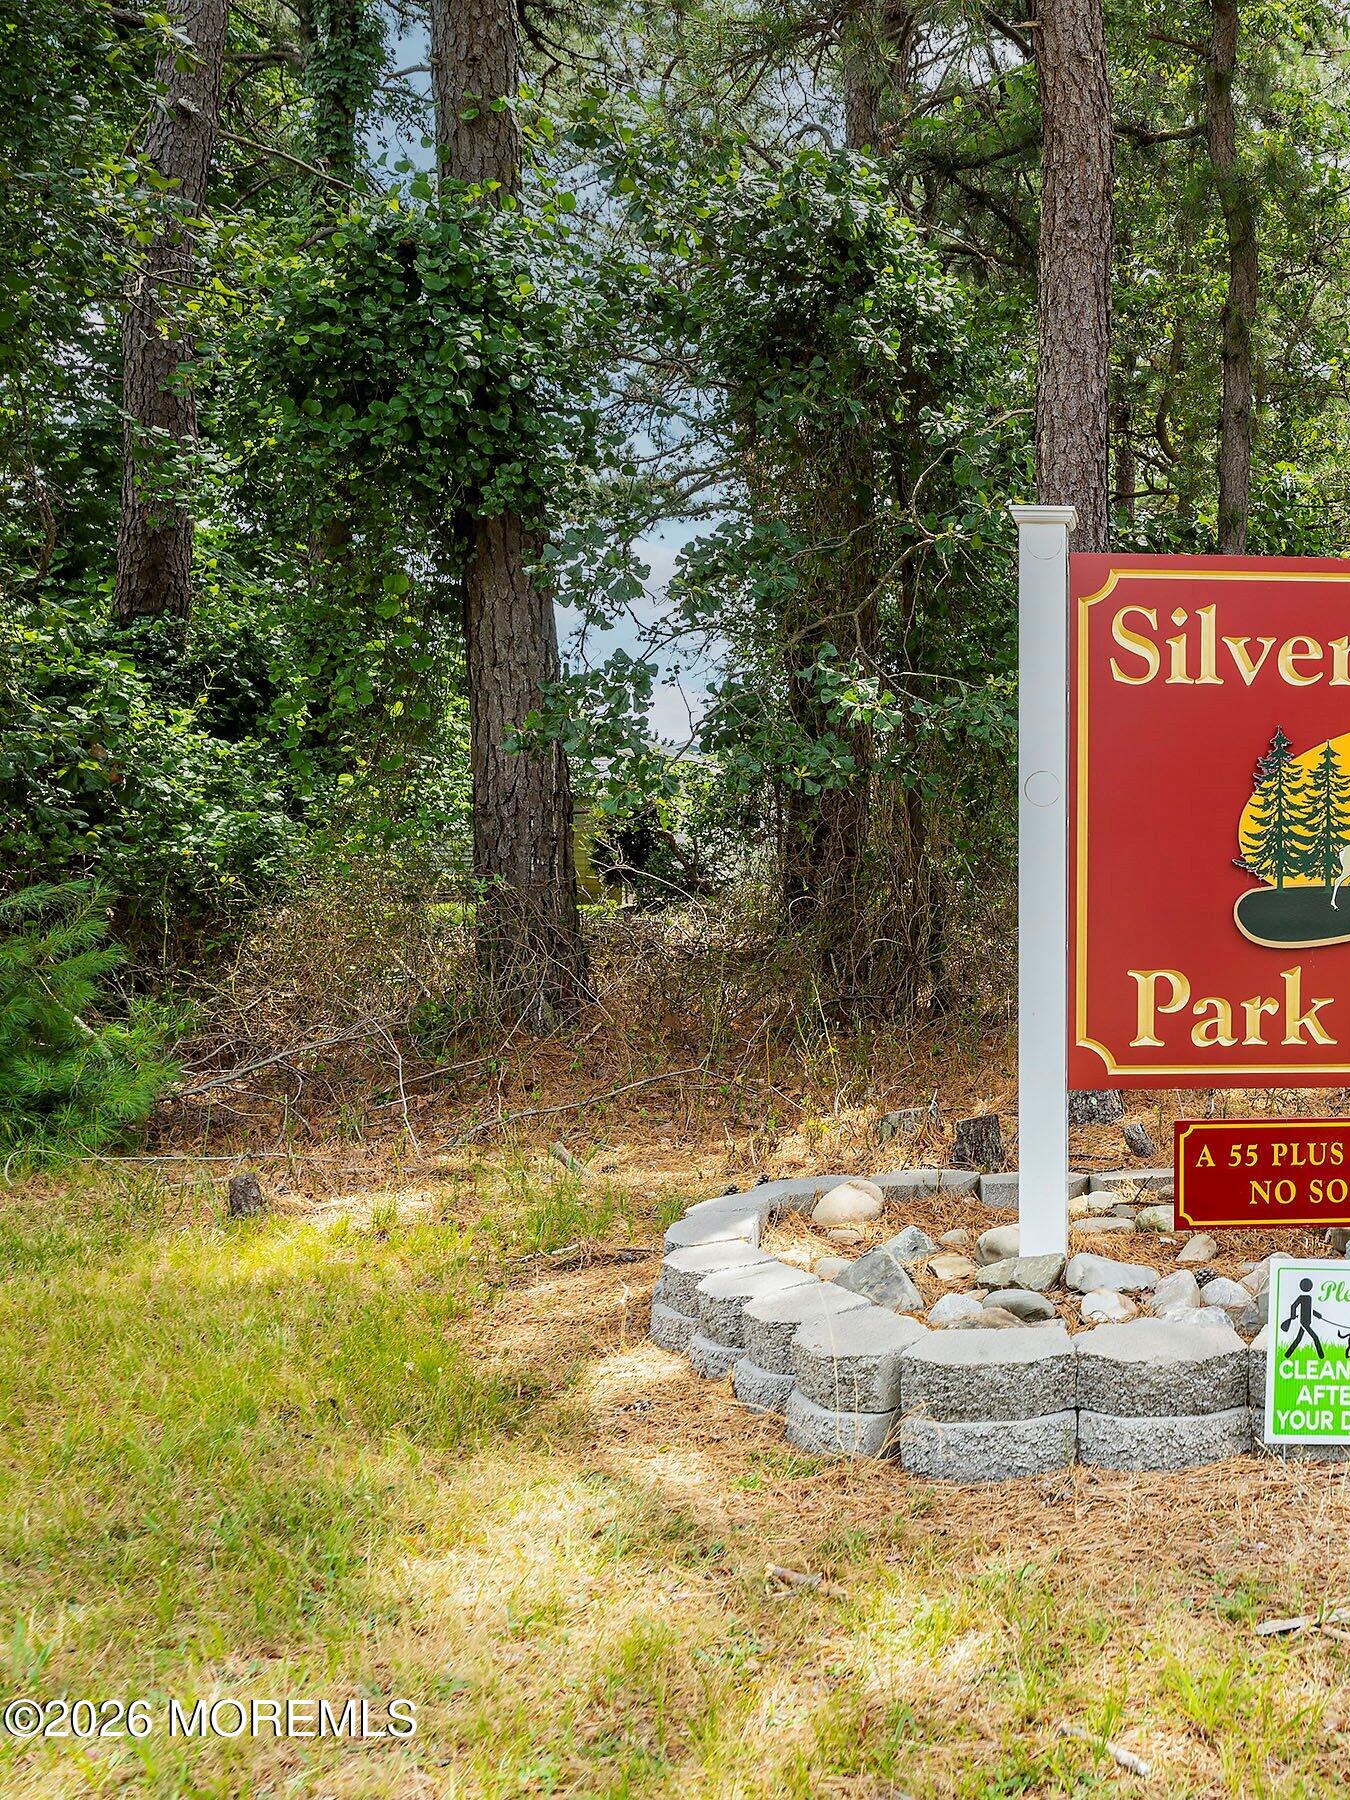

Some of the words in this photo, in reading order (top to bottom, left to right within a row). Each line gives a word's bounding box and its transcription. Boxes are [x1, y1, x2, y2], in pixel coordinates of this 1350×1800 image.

[1126, 966, 1338, 1048] Park
[1196, 1146, 1215, 1167] A
[1228, 1143, 1258, 1167] 55
[1271, 1141, 1344, 1167] PLUS
[1249, 1179, 1297, 1205] NO
[1279, 1359, 1350, 1380] CLEAN
[1276, 1409, 1335, 1431] YOUR
